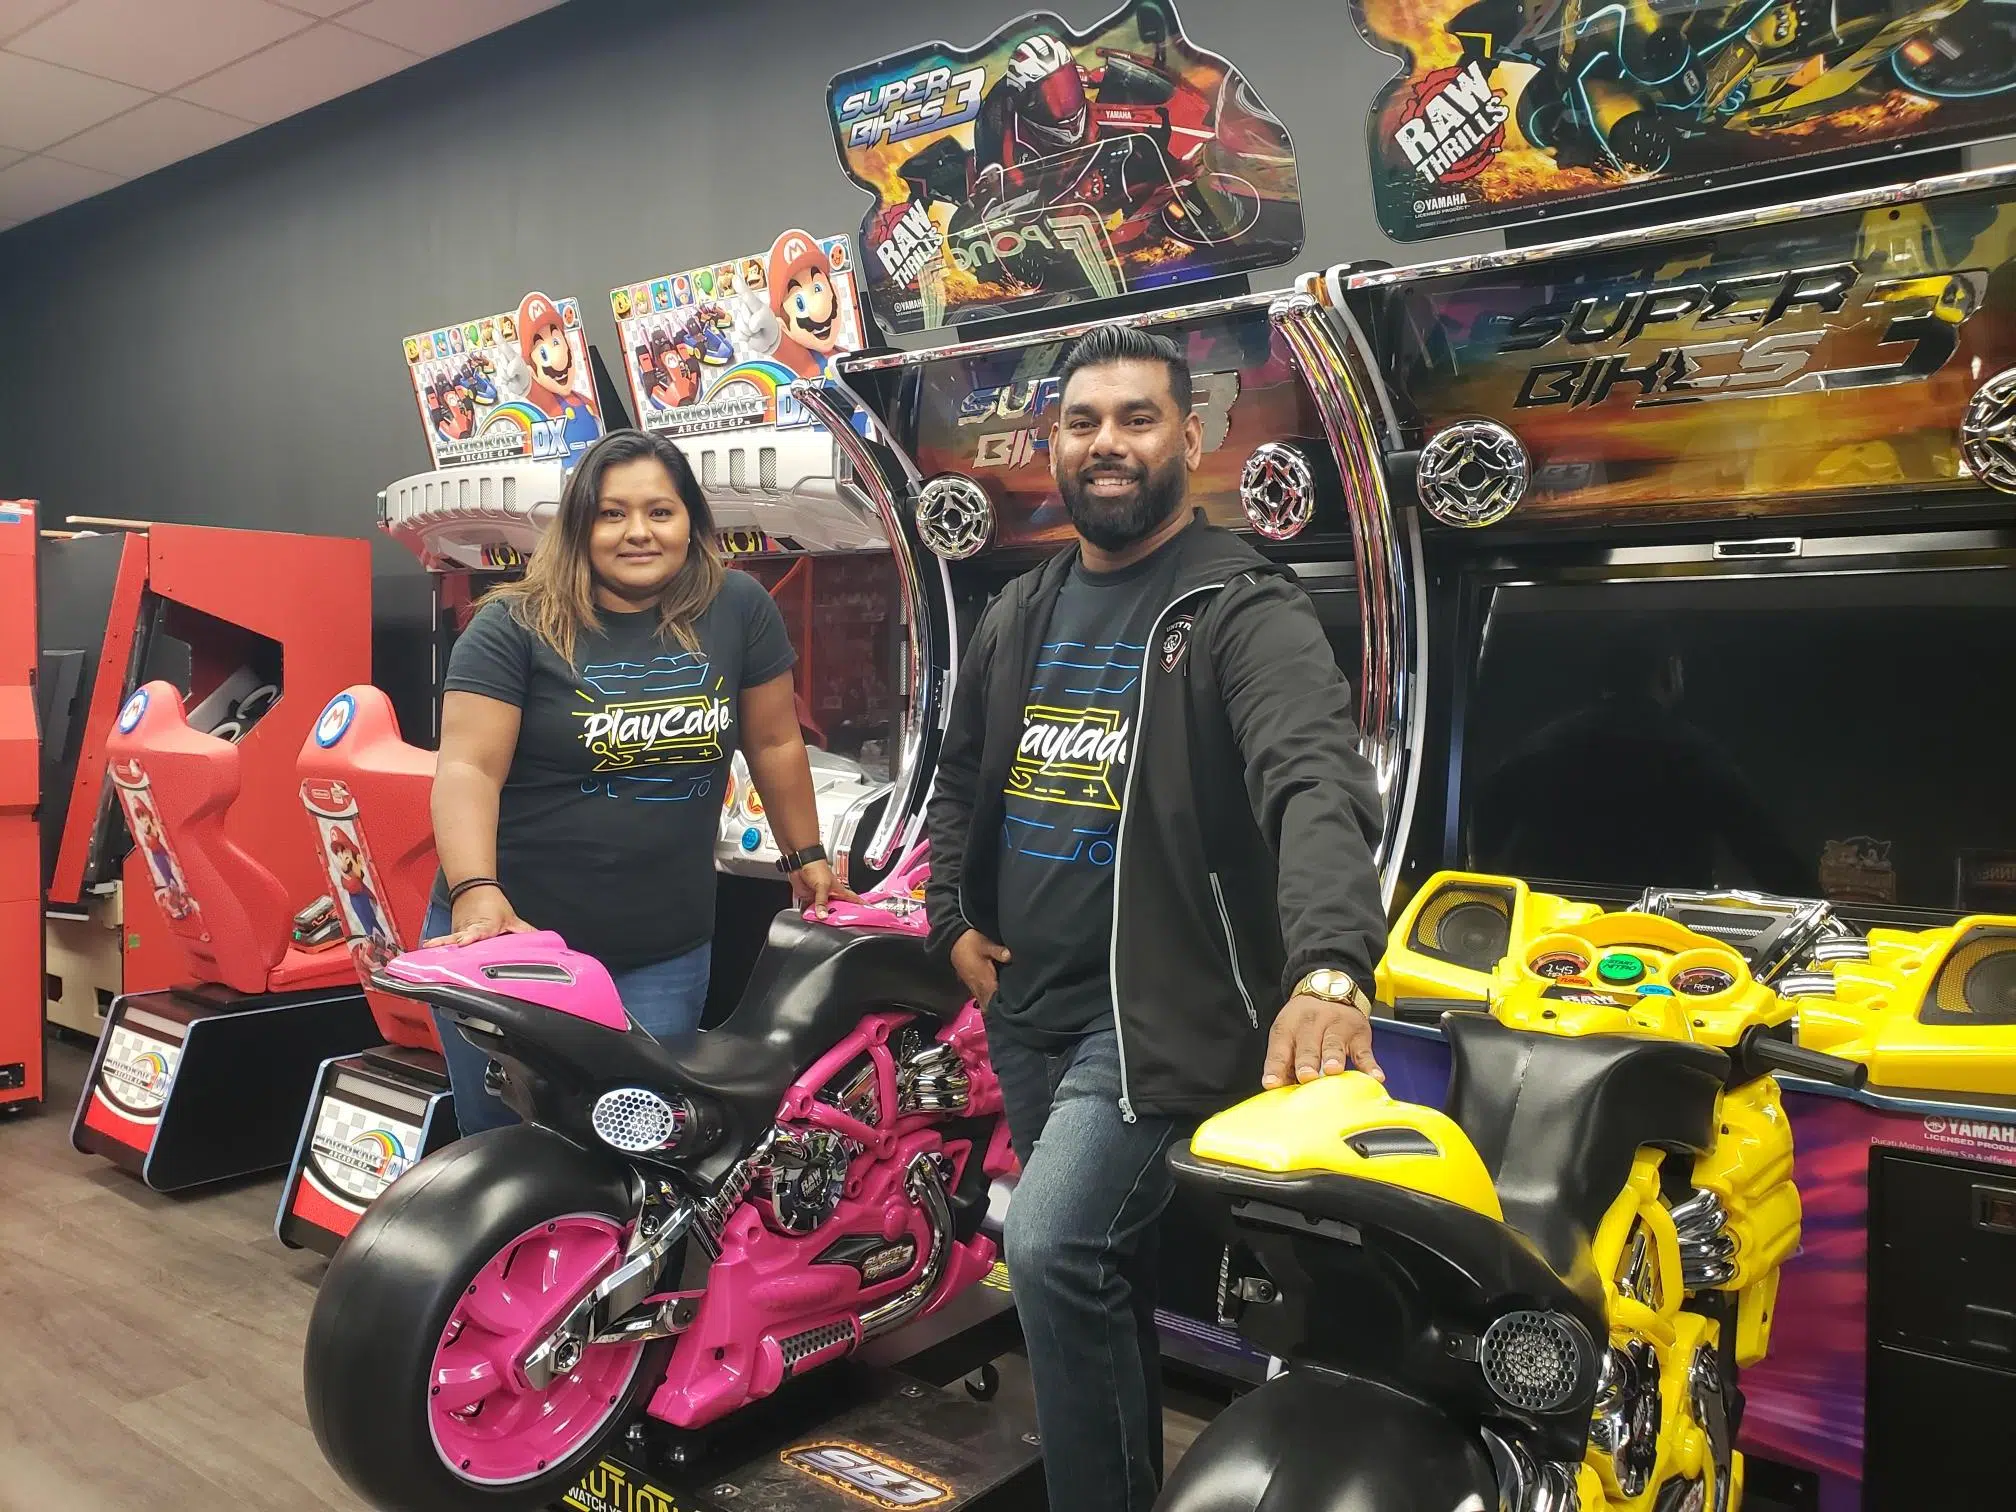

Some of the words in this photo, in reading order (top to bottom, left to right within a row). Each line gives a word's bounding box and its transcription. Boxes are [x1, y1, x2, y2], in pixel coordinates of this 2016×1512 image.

[840, 65, 951, 122] SUPER
[848, 95, 945, 151] BIKES
[1105, 110, 1132, 120] YAMAHA
[1394, 60, 1493, 165] RAW
[1416, 96, 1509, 183] THRILLS
[1414, 209, 1442, 219] LICENSED
[1425, 193, 1468, 211] YAMAHA
[876, 199, 931, 276] RAW
[892, 226, 944, 290] THRILLS
[1496, 260, 1863, 355] SUPER
[1511, 329, 1828, 412] BIKES
[531, 417, 570, 459] DX
[678, 421, 723, 434] ARCADE
[460, 451, 494, 463] ARCADE
[584, 698, 732, 751] PlayCade
[1693, 983, 1715, 991] RPM
[1871, 1136, 1897, 1146] Ducati
[1900, 1141, 1923, 1151] Motor
[1923, 1132, 1975, 1146] LICENSED
[1949, 1117, 2016, 1143] YAMAH
[801, 1168, 821, 1197] RAW
[792, 1450, 943, 1504] SB3
[568, 1486, 607, 1512] WATCH
